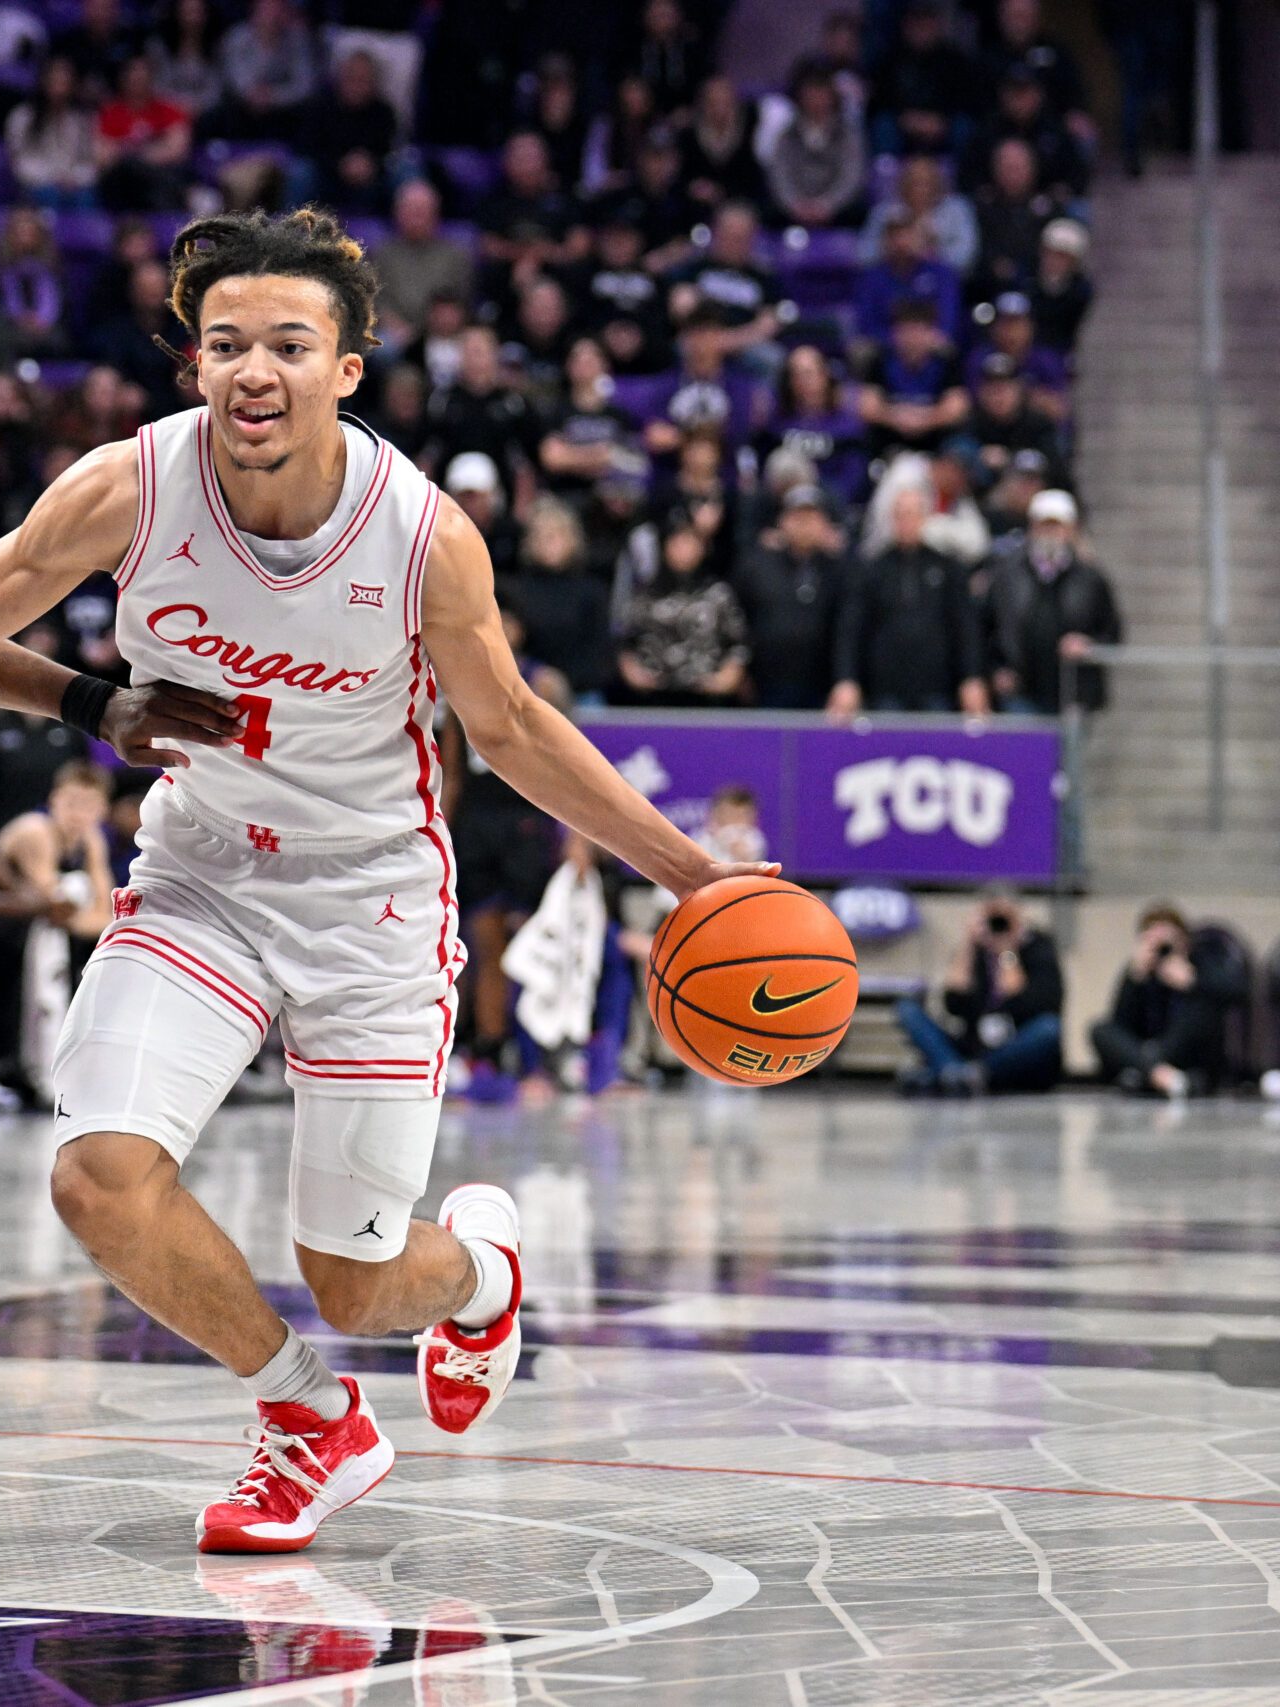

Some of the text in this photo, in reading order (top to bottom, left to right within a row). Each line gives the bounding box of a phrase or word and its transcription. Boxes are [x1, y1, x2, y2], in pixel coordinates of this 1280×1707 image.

[146, 603, 380, 693] Cougars
[231, 693, 273, 761] 4
[834, 754, 1014, 847] TCU
[726, 1042, 832, 1074] ELITE
